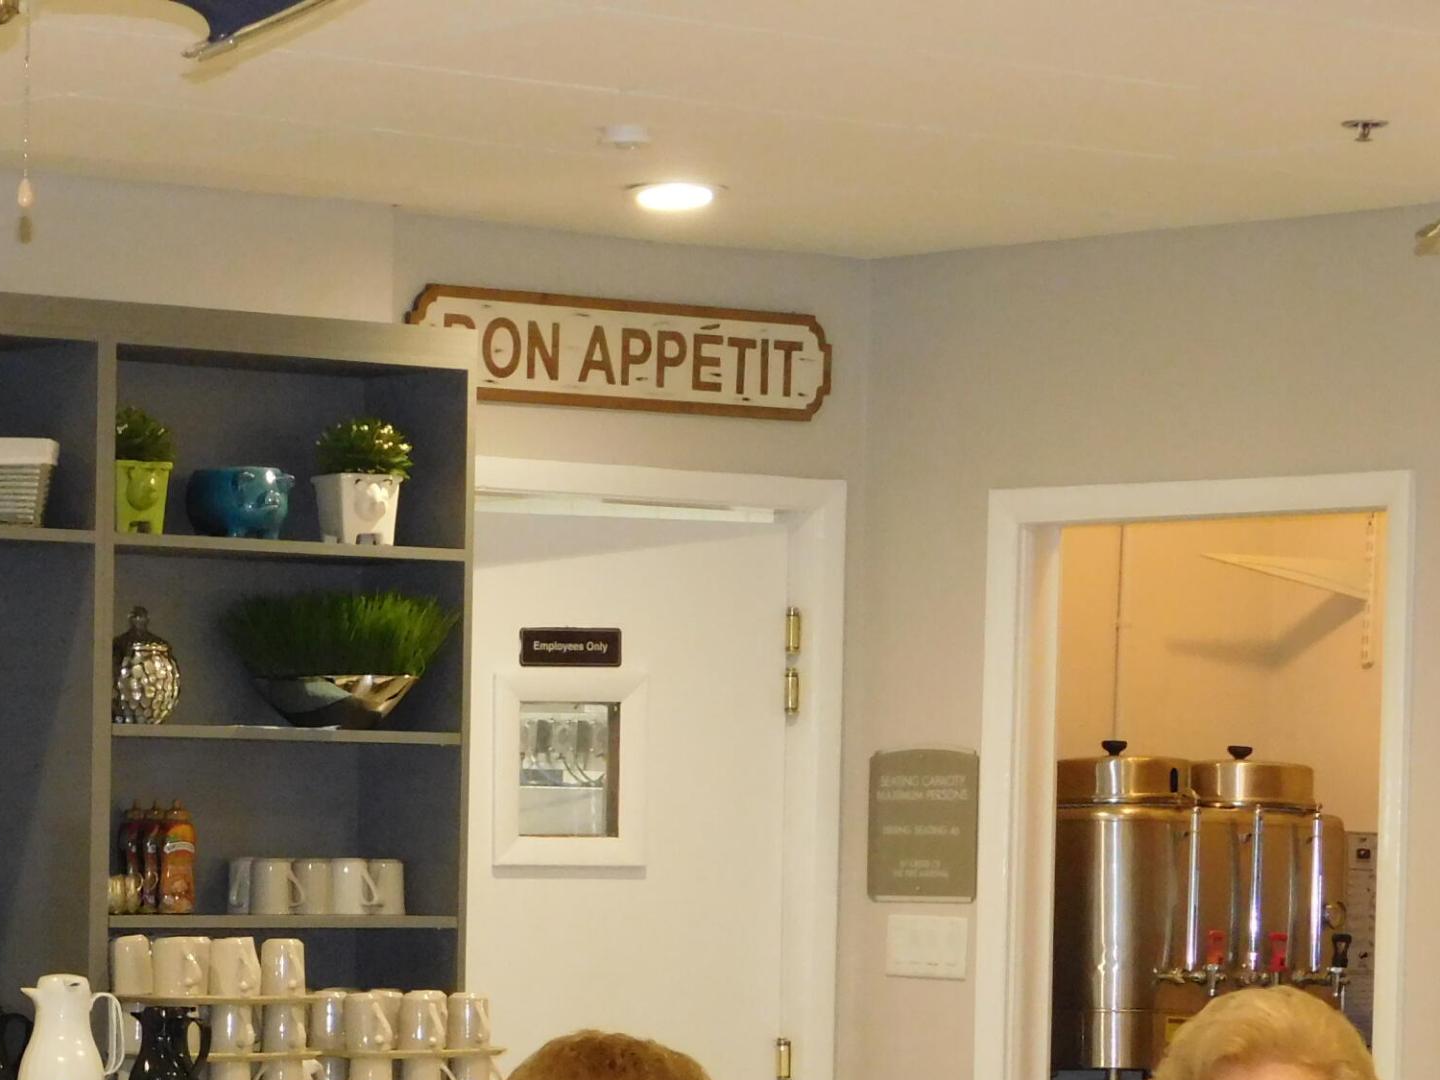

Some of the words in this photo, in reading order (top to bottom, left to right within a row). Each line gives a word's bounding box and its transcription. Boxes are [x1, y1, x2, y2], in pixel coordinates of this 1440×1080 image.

[444, 313, 559, 381] ON
[578, 323, 804, 397] APPÉTIT
[533, 640, 584, 653] Employees
[586, 641, 608, 654] Only
